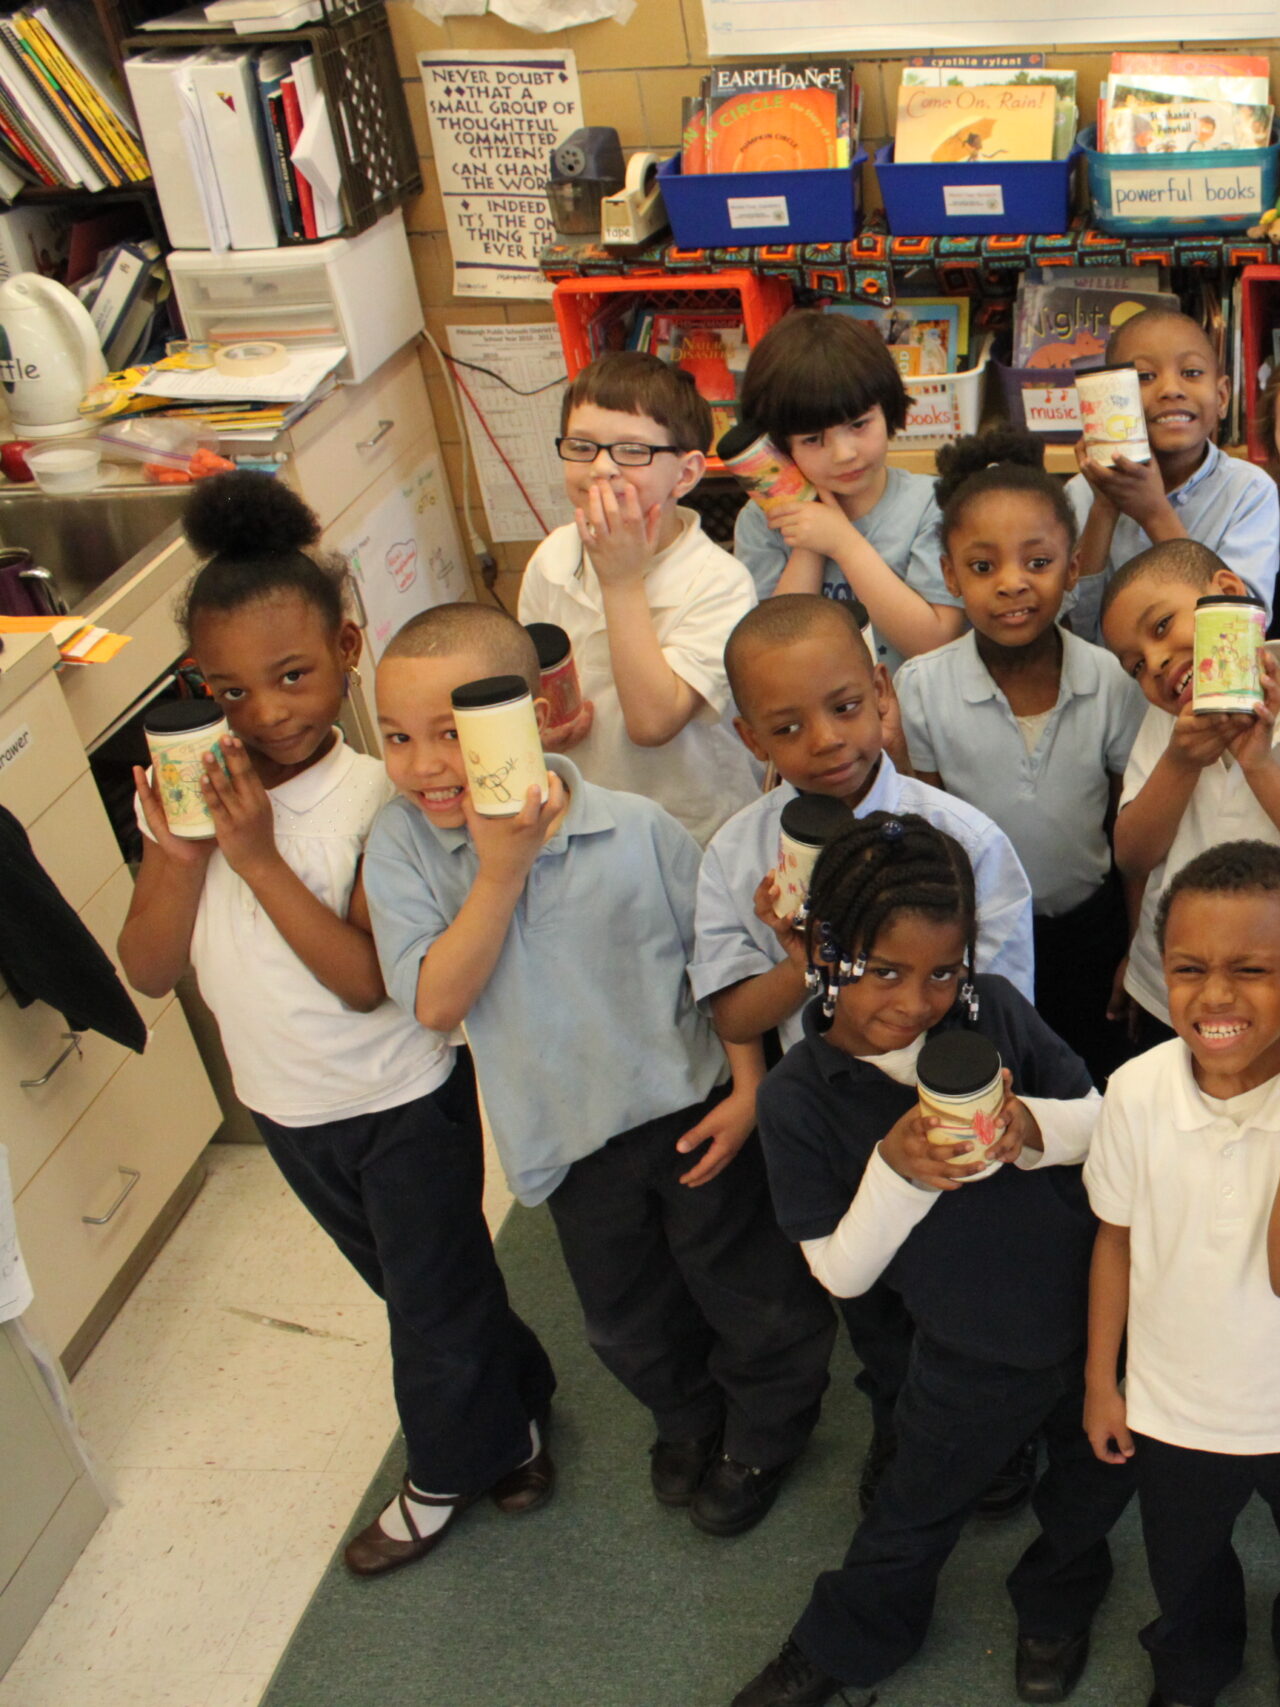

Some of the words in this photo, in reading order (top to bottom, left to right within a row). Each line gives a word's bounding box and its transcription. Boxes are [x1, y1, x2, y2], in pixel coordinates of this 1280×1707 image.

[931, 57, 978, 68] cynthia
[983, 56, 1022, 67] rylant
[432, 69, 490, 84] NEVER
[496, 71, 555, 85] DOUBT
[717, 67, 842, 90] EARTHDANCE
[466, 86, 514, 99] THAT
[521, 87, 533, 100] A
[430, 100, 484, 114] SMALL
[489, 101, 549, 116] GROUP
[553, 101, 576, 115] OF
[719, 95, 786, 127] CIRCLE
[906, 90, 951, 119] Come
[1000, 91, 1046, 110] Rain!
[436, 117, 559, 132] THOUGHTFUL
[454, 132, 557, 146] COMMITTED
[469, 146, 545, 159] CITIZENS
[452, 163, 488, 176] CAN
[495, 163, 551, 177] CHAN
[461, 177, 495, 190] THE
[1115, 176, 1193, 213] powerful
[1204, 176, 1256, 202] books
[487, 199, 547, 214] INDEED
[458, 213, 485, 228] IT'S
[493, 214, 527, 229] THE
[466, 228, 522, 243] THING
[606, 226, 632, 240] tape
[484, 244, 528, 260] EVER
[1024, 296, 1105, 349] Night
[1031, 402, 1078, 420] music
[0, 731, 29, 769] rawer
